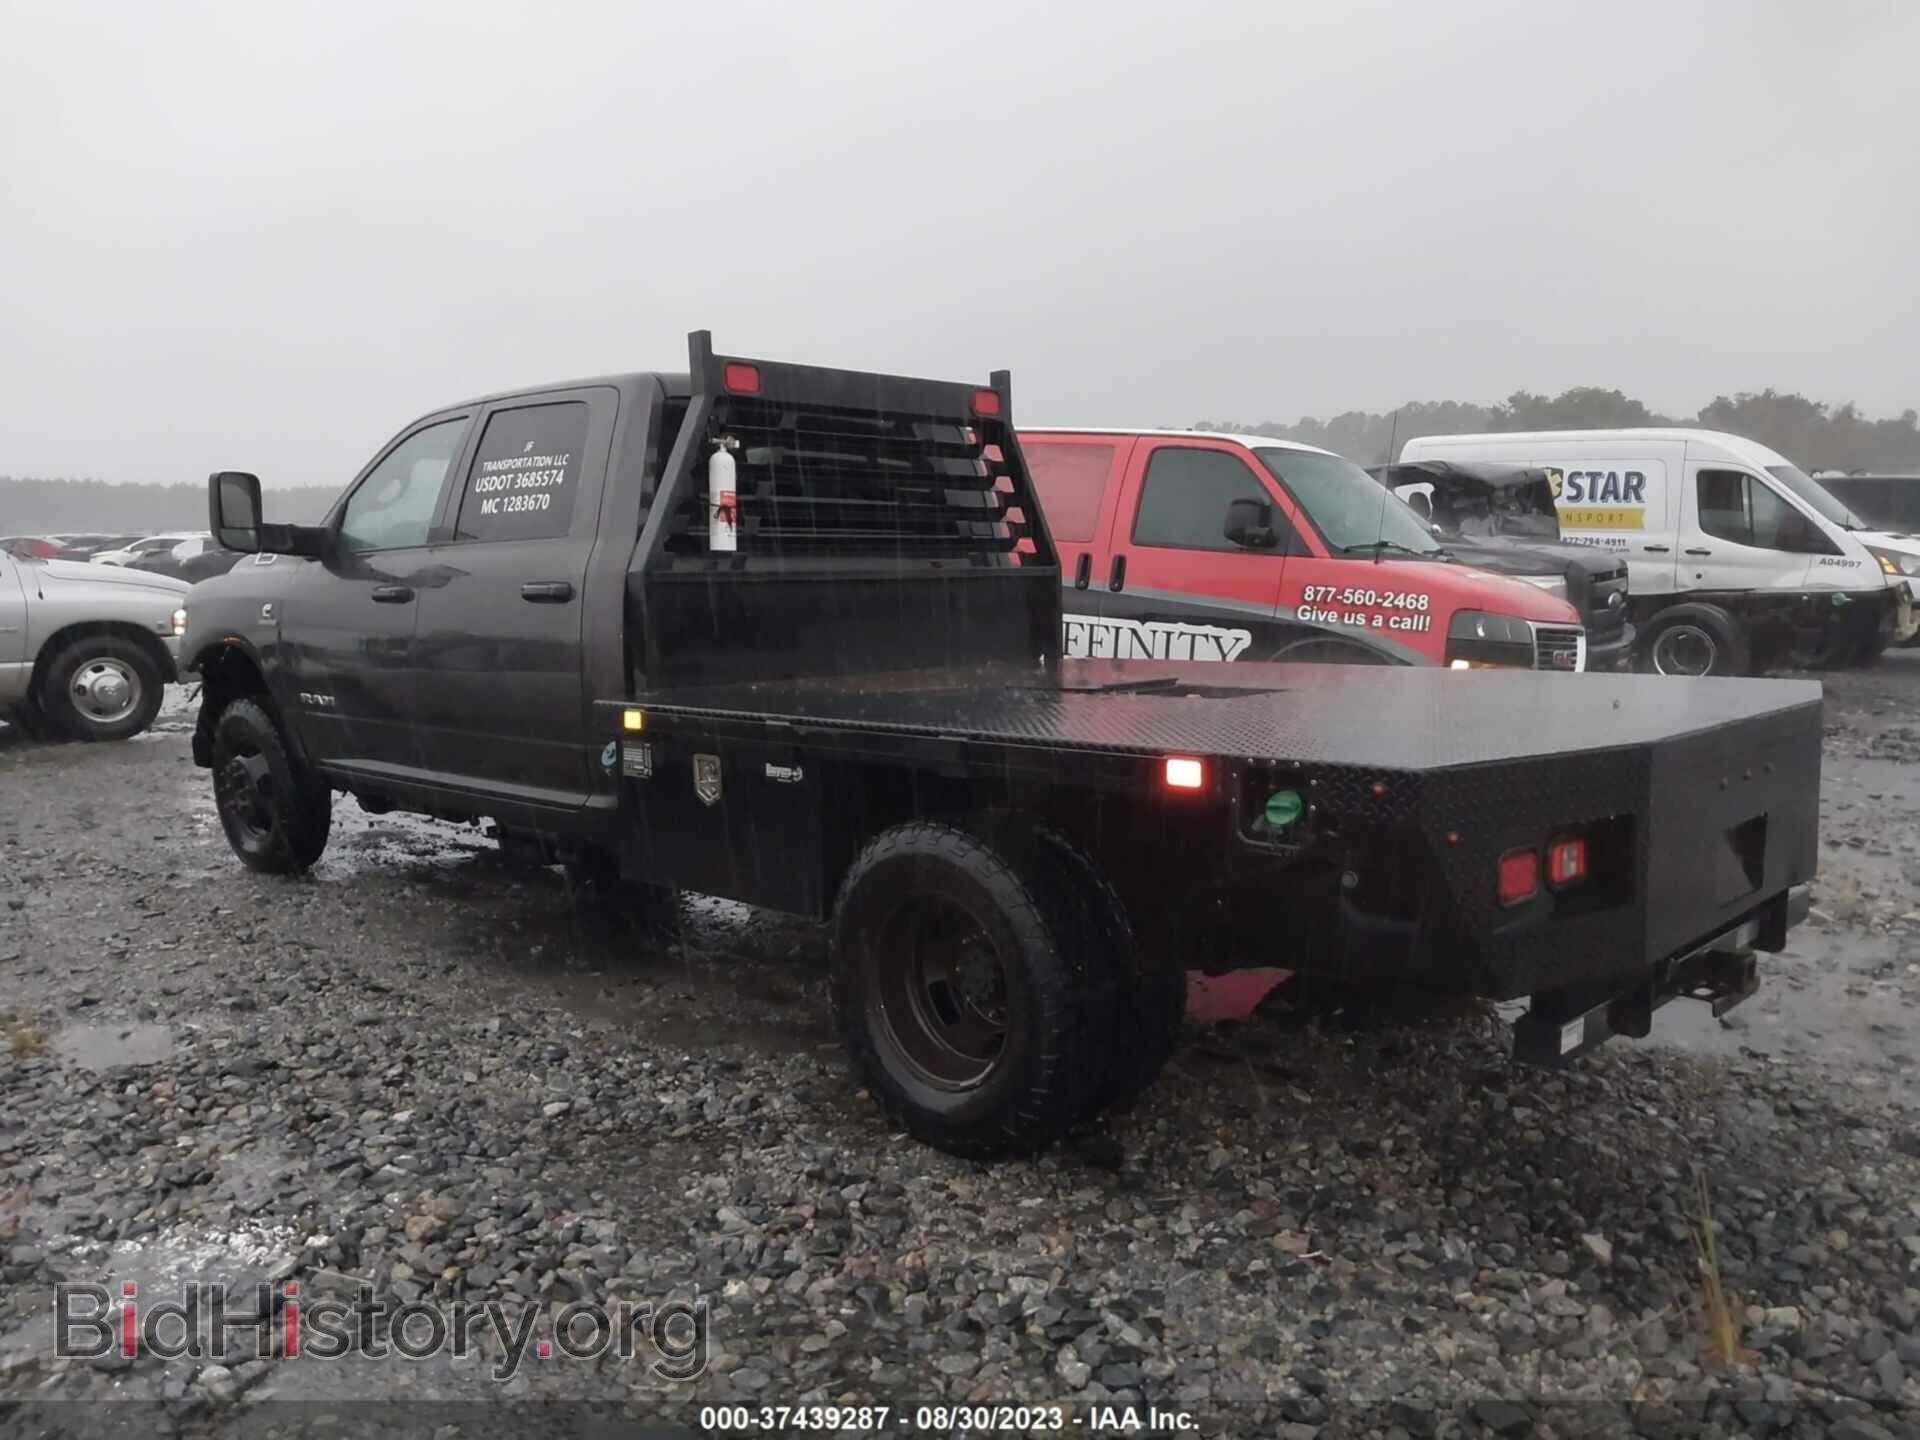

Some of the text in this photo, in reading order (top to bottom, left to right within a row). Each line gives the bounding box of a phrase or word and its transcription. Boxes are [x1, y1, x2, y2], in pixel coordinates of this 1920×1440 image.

[483, 453, 570, 473] TRANSPORTATION LLC
[475, 469, 564, 493] USDOT 3685574
[1566, 470, 1647, 503] STAR
[480, 494, 550, 515] MC 1283670
[1304, 585, 1429, 611] 877-560-2468
[1297, 605, 1431, 631] Give us a call!
